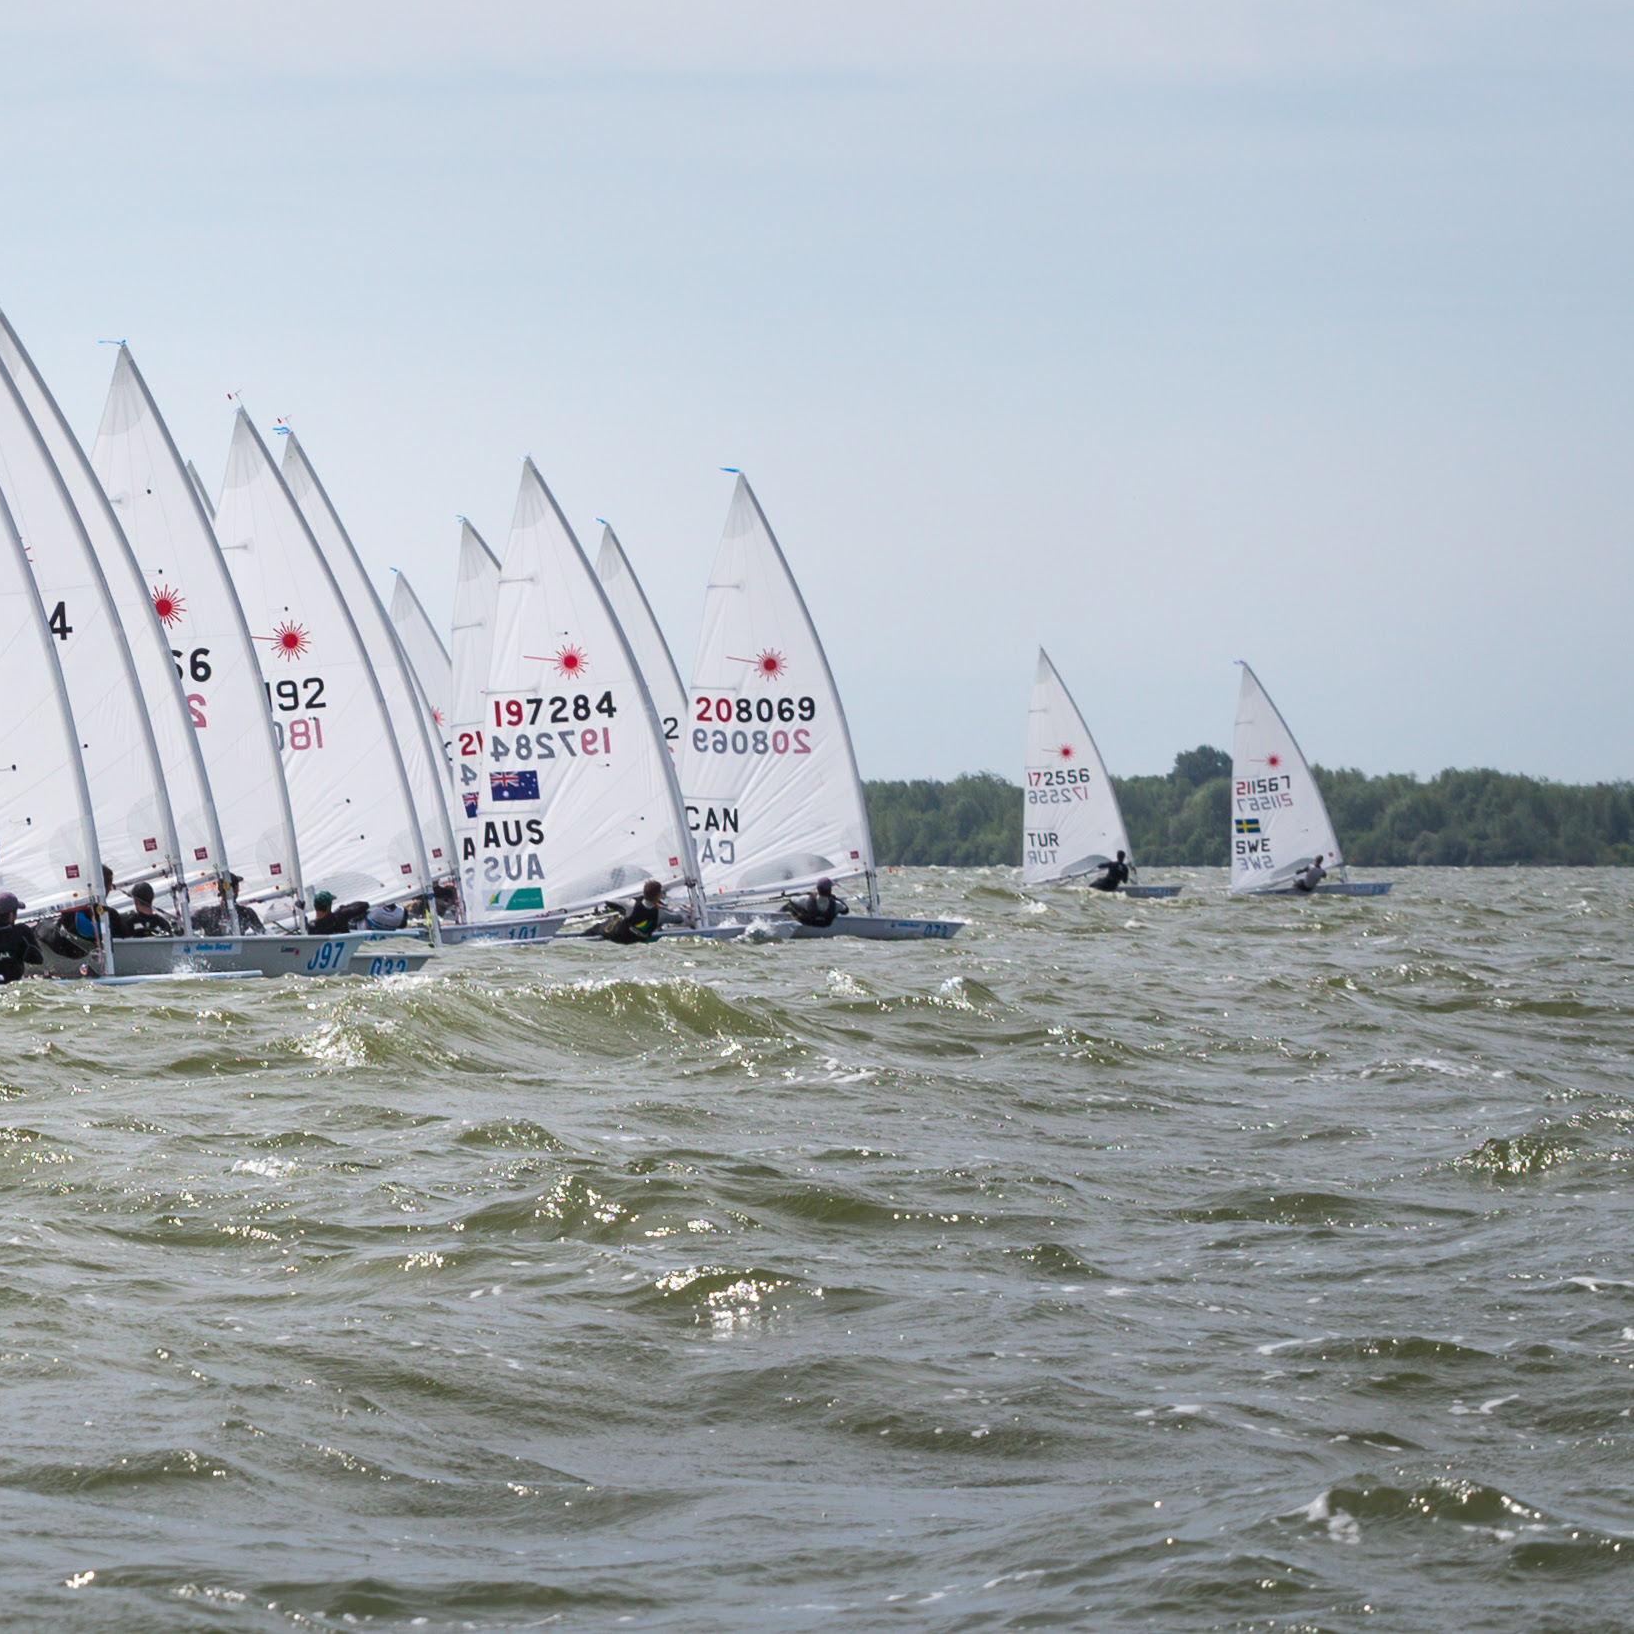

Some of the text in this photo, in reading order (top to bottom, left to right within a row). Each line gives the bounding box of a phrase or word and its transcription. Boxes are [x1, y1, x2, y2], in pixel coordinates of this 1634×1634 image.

[494, 691, 617, 727] 197284
[695, 696, 816, 723] 208069
[1028, 768, 1090, 786] 172556
[1236, 775, 1290, 796] 211567
[685, 805, 739, 833] CAN
[484, 819, 545, 848] AUS
[1027, 832, 1059, 847] TUR
[1235, 838, 1271, 854] SWE
